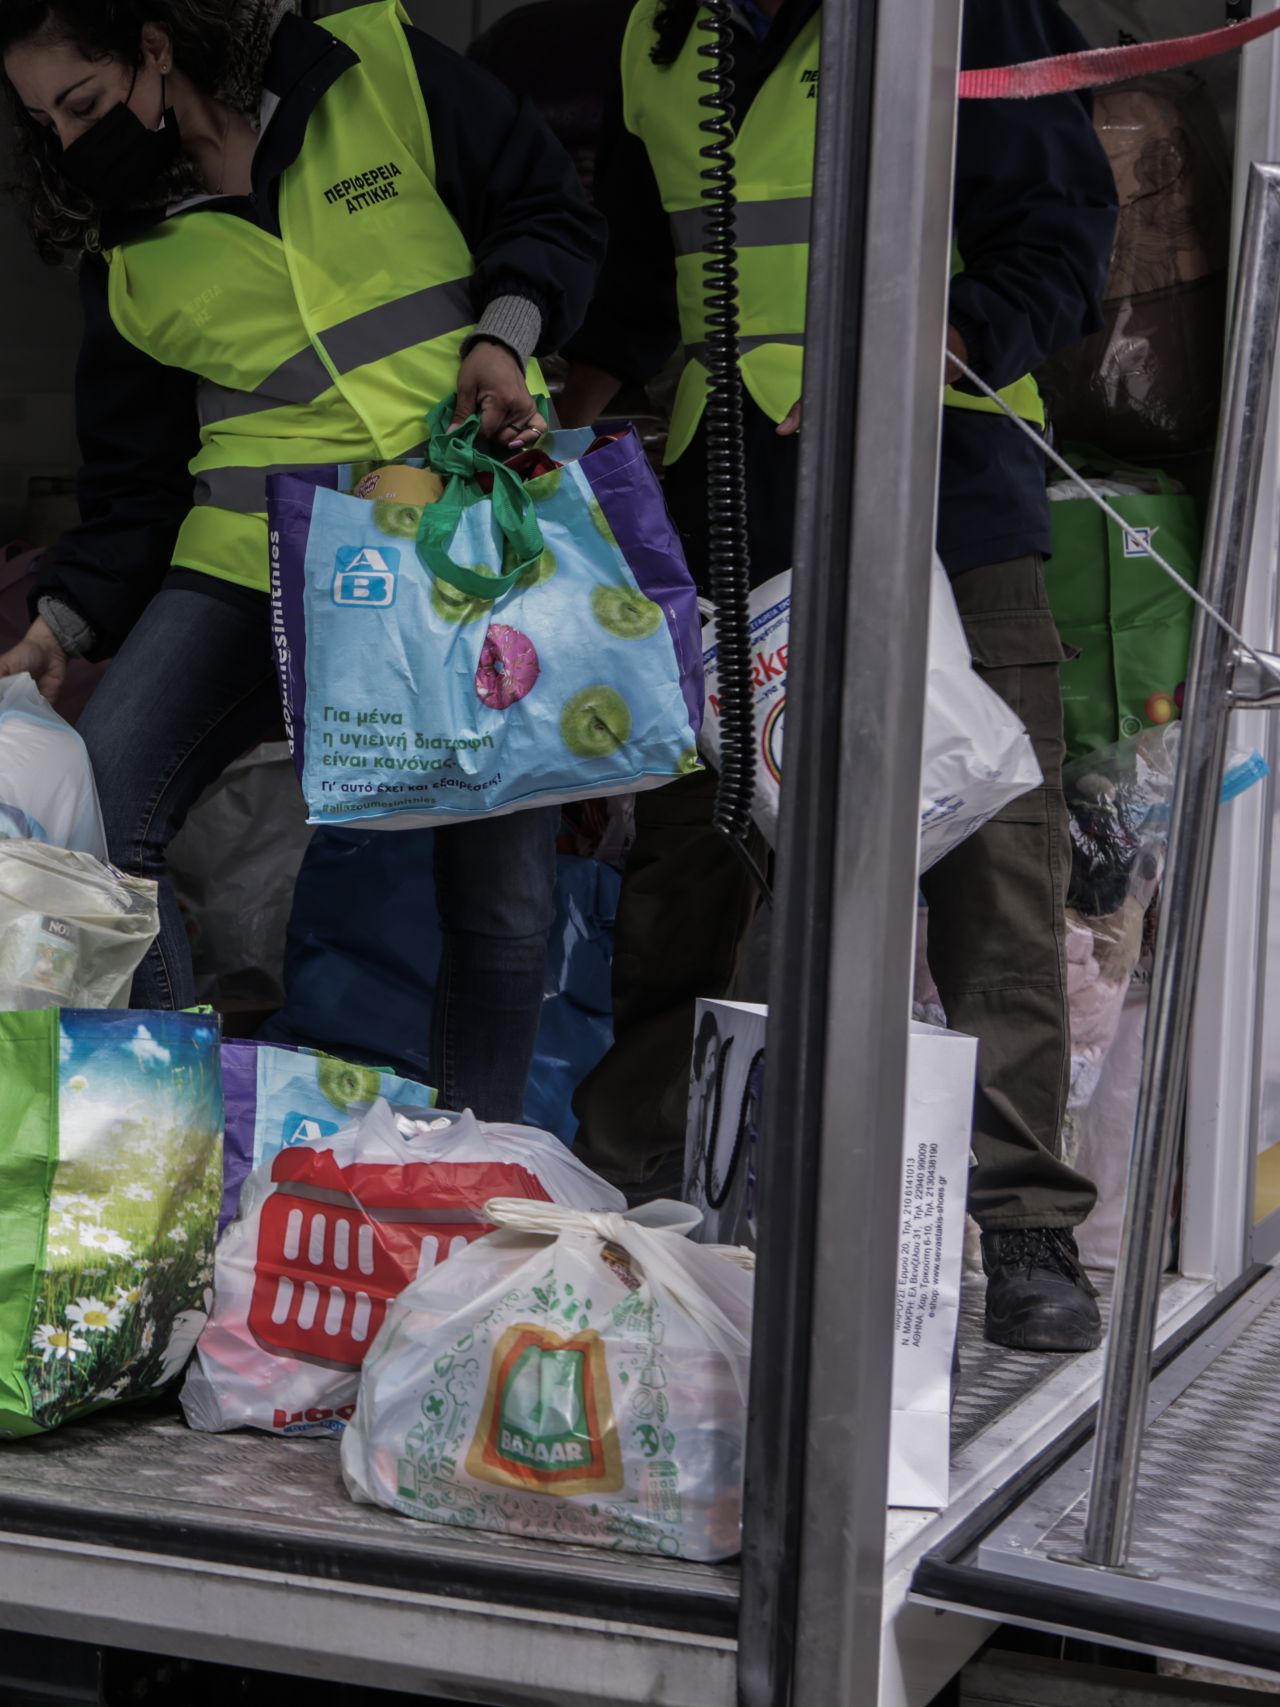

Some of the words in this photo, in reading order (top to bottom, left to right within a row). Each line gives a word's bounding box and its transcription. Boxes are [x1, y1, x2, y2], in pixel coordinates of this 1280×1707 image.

[323, 162, 402, 204] ΠΕΡΙΦΕΡΕΙΑ
[345, 181, 399, 214] ΑΤΤΙΚΗΣ
[324, 706, 350, 723] Για
[357, 708, 403, 726] μένα
[323, 732, 333, 747] η
[340, 732, 407, 750] υγιεινή
[414, 732, 494, 752] διατροφή
[322, 751, 367, 768] είναι
[340, 781, 373, 793] αυτό
[377, 784, 404, 793] έχει
[904, 1198, 913, 1215] 210
[932, 1176, 948, 1285] www.sevastakis-shoes.gr
[500, 1429, 585, 1463] BAZAAR
